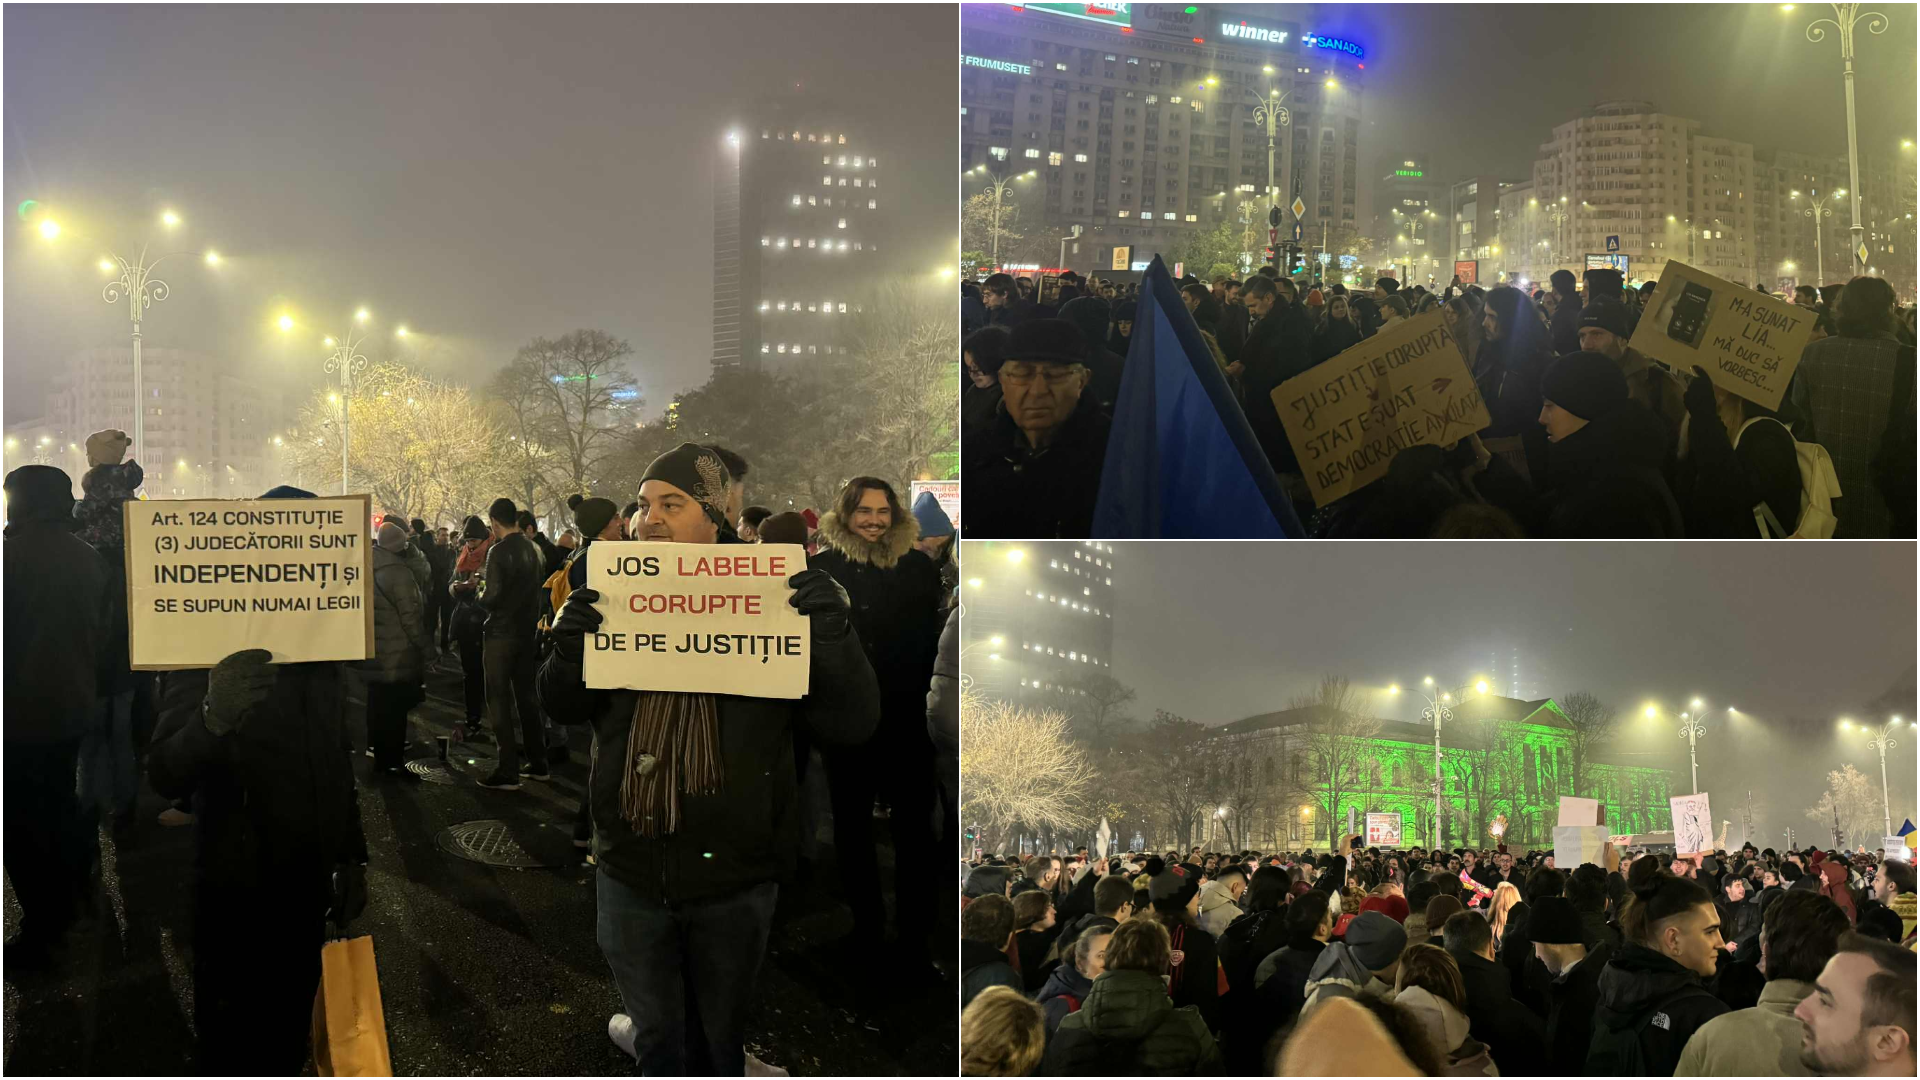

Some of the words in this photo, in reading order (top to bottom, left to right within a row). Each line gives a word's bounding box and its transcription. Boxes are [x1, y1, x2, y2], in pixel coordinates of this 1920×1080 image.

[1222, 20, 1288, 43] winner
[1317, 36, 1365, 59] SANADOR
[965, 55, 1031, 75] FRUMUSETE
[1752, 306, 1801, 334] SUNAT
[1385, 324, 1454, 369] CORUPTĂ
[1713, 336, 1735, 353] MĂ
[1735, 345, 1760, 364] DUC
[1761, 356, 1784, 374] SĂ
[1305, 418, 1354, 460] STAT
[151, 512, 183, 525] Art.
[188, 512, 218, 526] 124
[223, 510, 343, 530] CONSTITUȚIE
[155, 536, 179, 553] (3)
[184, 532, 303, 550] JUDECĂTORII
[309, 534, 357, 549] SUNT
[154, 563, 338, 590] INDEPENDENȚI
[343, 567, 359, 586] ȘI
[606, 556, 660, 576] JOS
[677, 556, 786, 577] LABELE
[154, 599, 178, 613] SE
[183, 598, 246, 613] SUPUN
[252, 597, 311, 612] NUMAI
[317, 596, 360, 611] LEGII
[629, 594, 762, 615] CORUPTE
[594, 633, 627, 651] DE
[635, 633, 667, 653] PE
[675, 634, 802, 664] JUSTIȚIE
